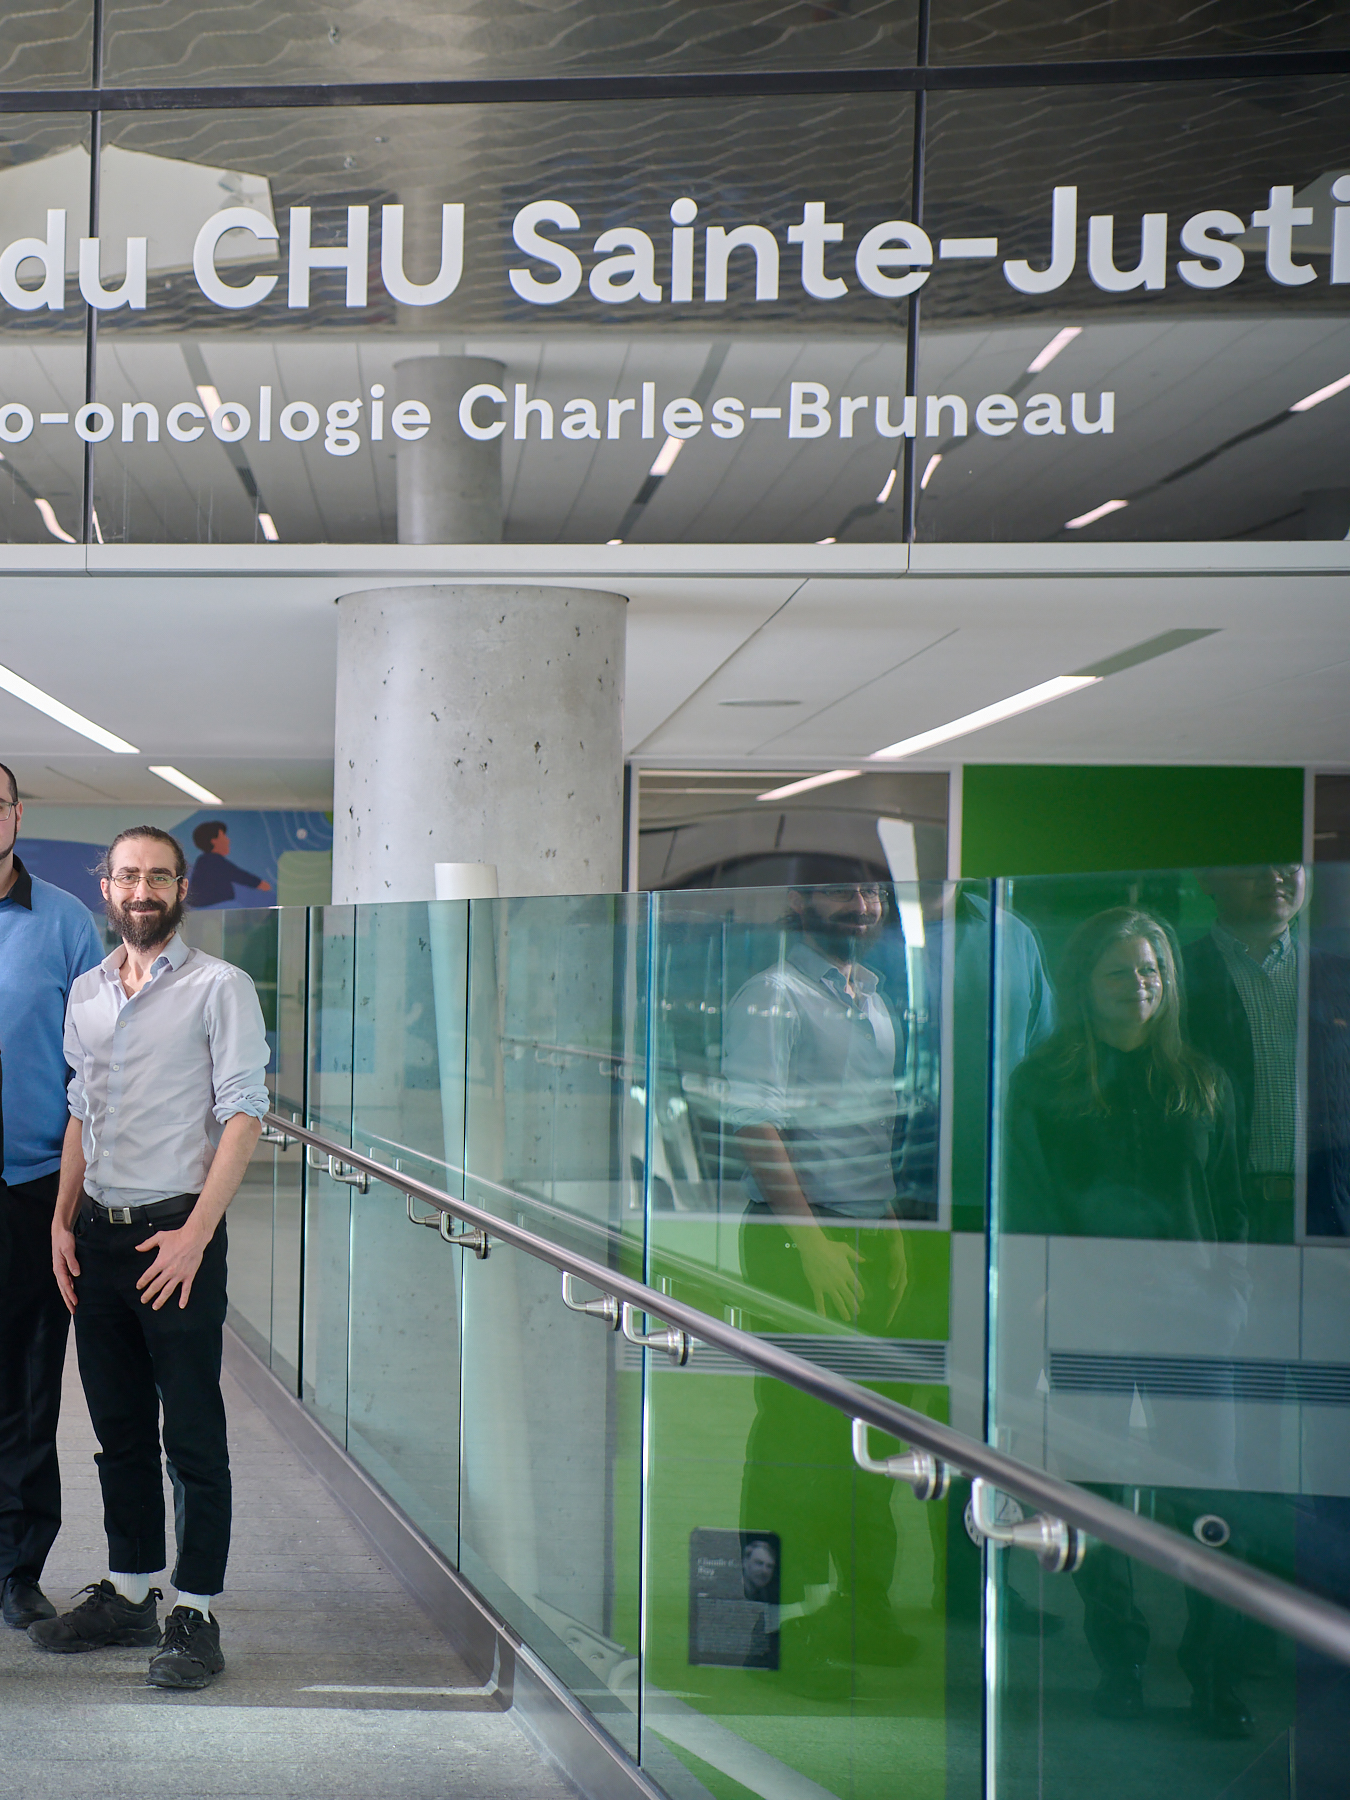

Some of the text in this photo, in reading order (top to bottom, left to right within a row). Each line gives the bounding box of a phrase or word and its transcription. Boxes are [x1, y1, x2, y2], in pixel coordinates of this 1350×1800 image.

[193, 203, 464, 309] CHU
[508, 174, 1350, 305] Sainte-Justi
[459, 381, 1115, 440] Charles-Bruneau
